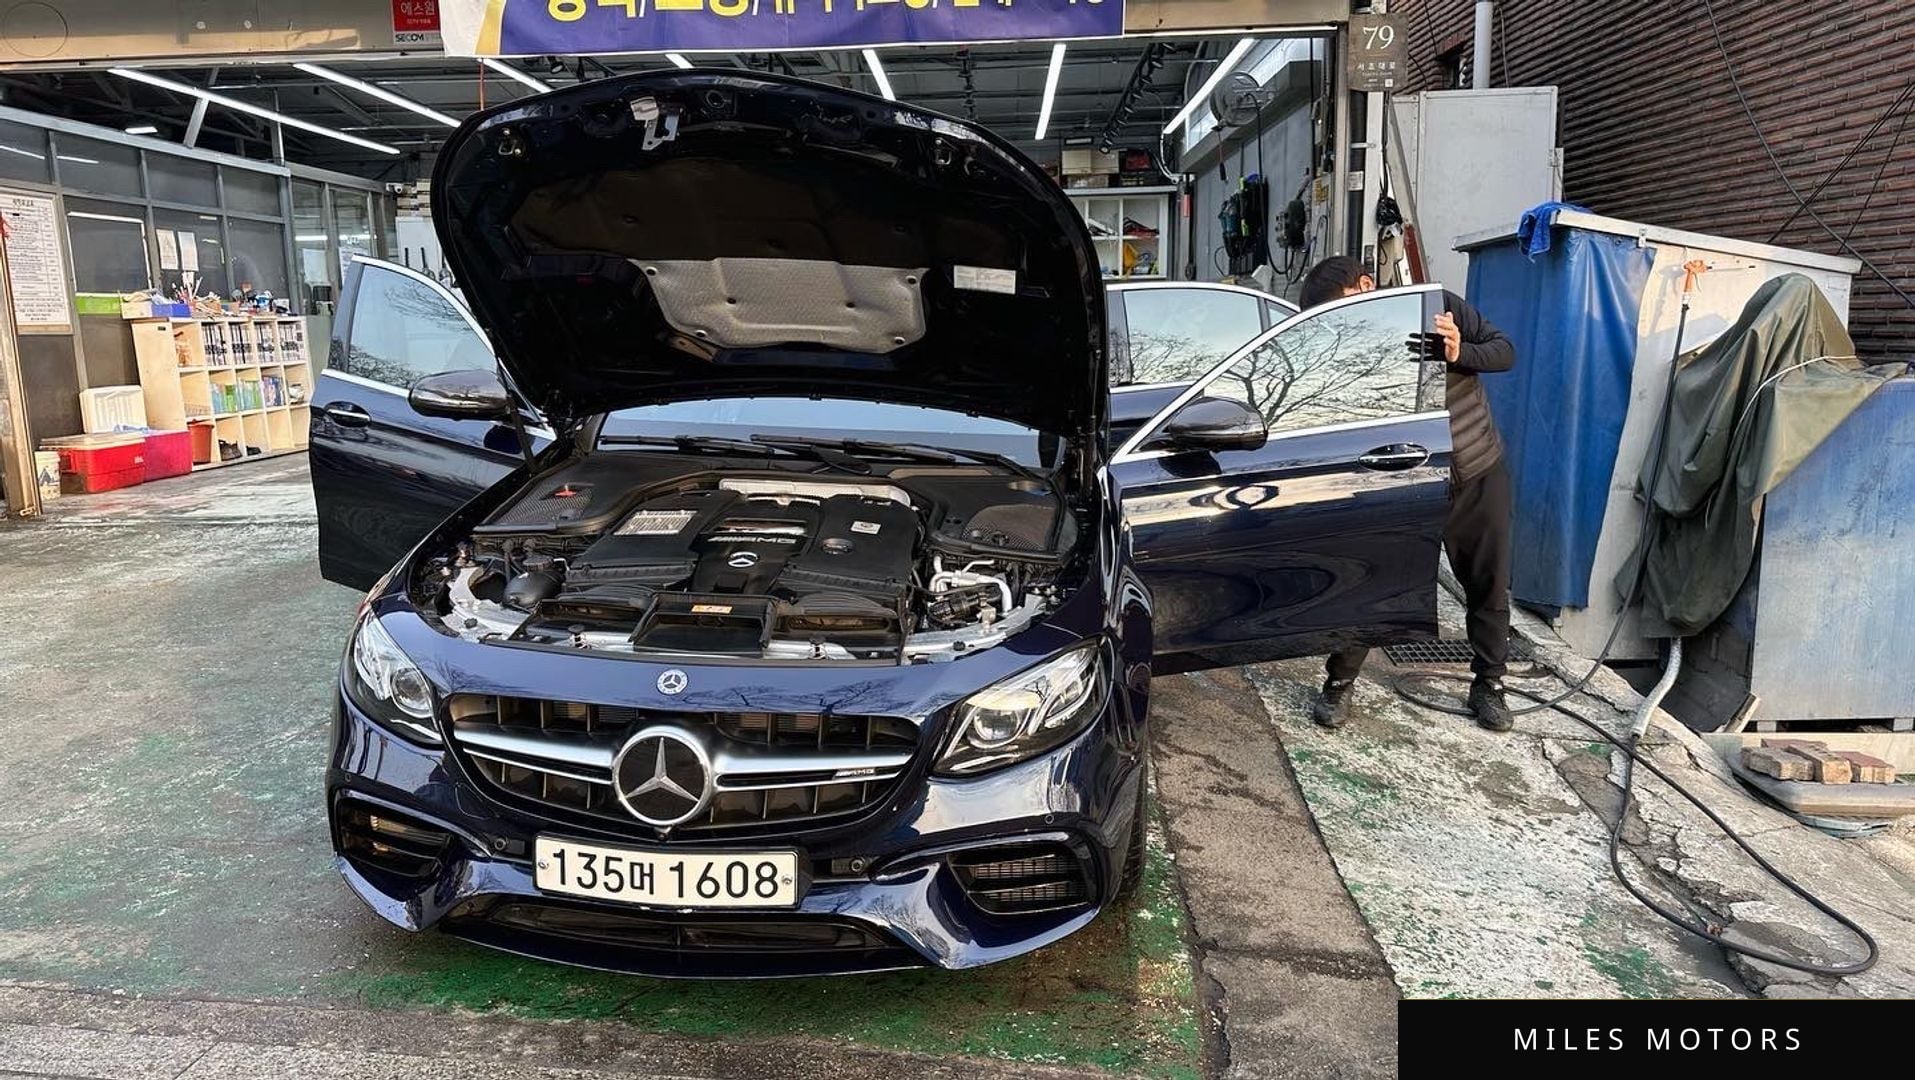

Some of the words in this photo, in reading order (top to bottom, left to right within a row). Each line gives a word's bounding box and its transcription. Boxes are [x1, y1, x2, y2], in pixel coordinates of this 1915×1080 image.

[400, 1, 435, 16] 에스원
[395, 33, 424, 42] SECOM
[1362, 25, 1394, 50] 79
[1356, 61, 1396, 71] 서초대로
[552, 848, 654, 895] 135머
[669, 860, 779, 899] 1608
